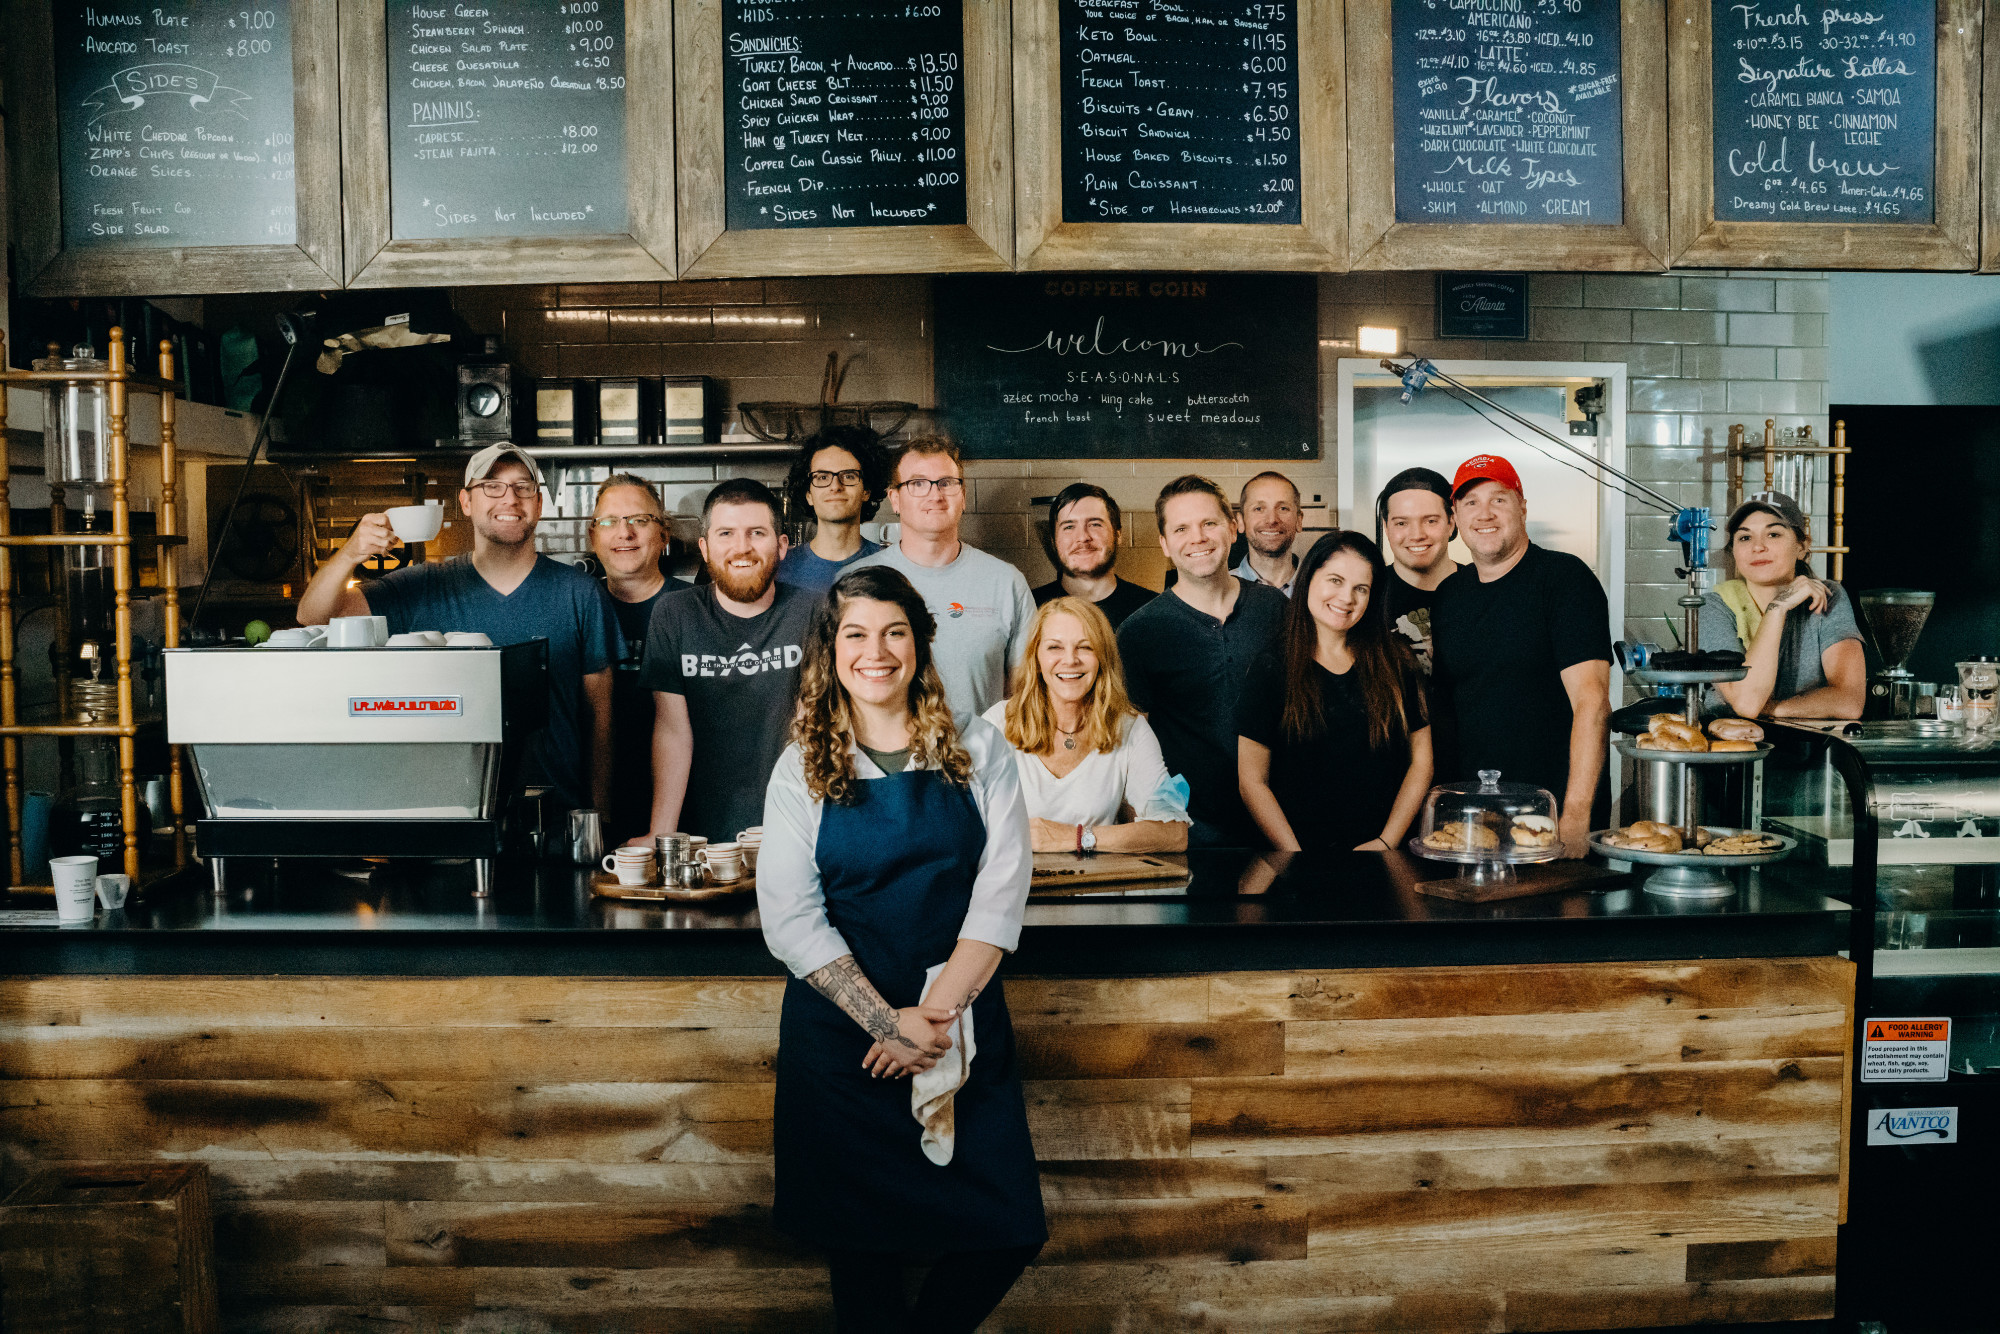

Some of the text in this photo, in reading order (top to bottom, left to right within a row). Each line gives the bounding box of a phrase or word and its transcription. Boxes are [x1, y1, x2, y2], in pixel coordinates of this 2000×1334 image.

[744, 9, 774, 22] KIDS
[1468, 13, 1531, 29] AMERICANO
[1730, 3, 1883, 34] French press
[1481, 46, 1522, 62] LATTE
[127, 71, 198, 92] SIDES
[1738, 56, 1834, 93] Signature
[826, 77, 850, 89] BLT
[1751, 88, 1900, 107] CARAMEL BIANCA SAMOA
[1531, 112, 1576, 124] COCONUT
[1752, 114, 1897, 129] HONEY BEE CINNAMON
[420, 132, 464, 145] CAPRESE
[1424, 125, 1590, 139] HAZELNUT LAVENDER PEPPERMINT
[1845, 132, 1882, 145] LECHE
[461, 148, 496, 156] FAJITA
[1425, 139, 1544, 153] DARK CHOCOLATE WHITE
[1729, 136, 1900, 176] Cold brew
[1427, 181, 1504, 193] WHOLE OAT
[1428, 199, 1590, 215] SKIM ALMOND CREAM
[1734, 197, 1775, 214] Dreamy
[1046, 281, 1208, 297] COPPER COIN
[1461, 297, 1506, 312] Atlanta
[987, 316, 1243, 358] welcome
[1003, 391, 1249, 412] aztec mocha king cake butterscotch
[1025, 411, 1260, 424] french toast sweet meadows
[682, 642, 802, 676] BEYOND
[1874, 1112, 1950, 1138] AVANTCO
